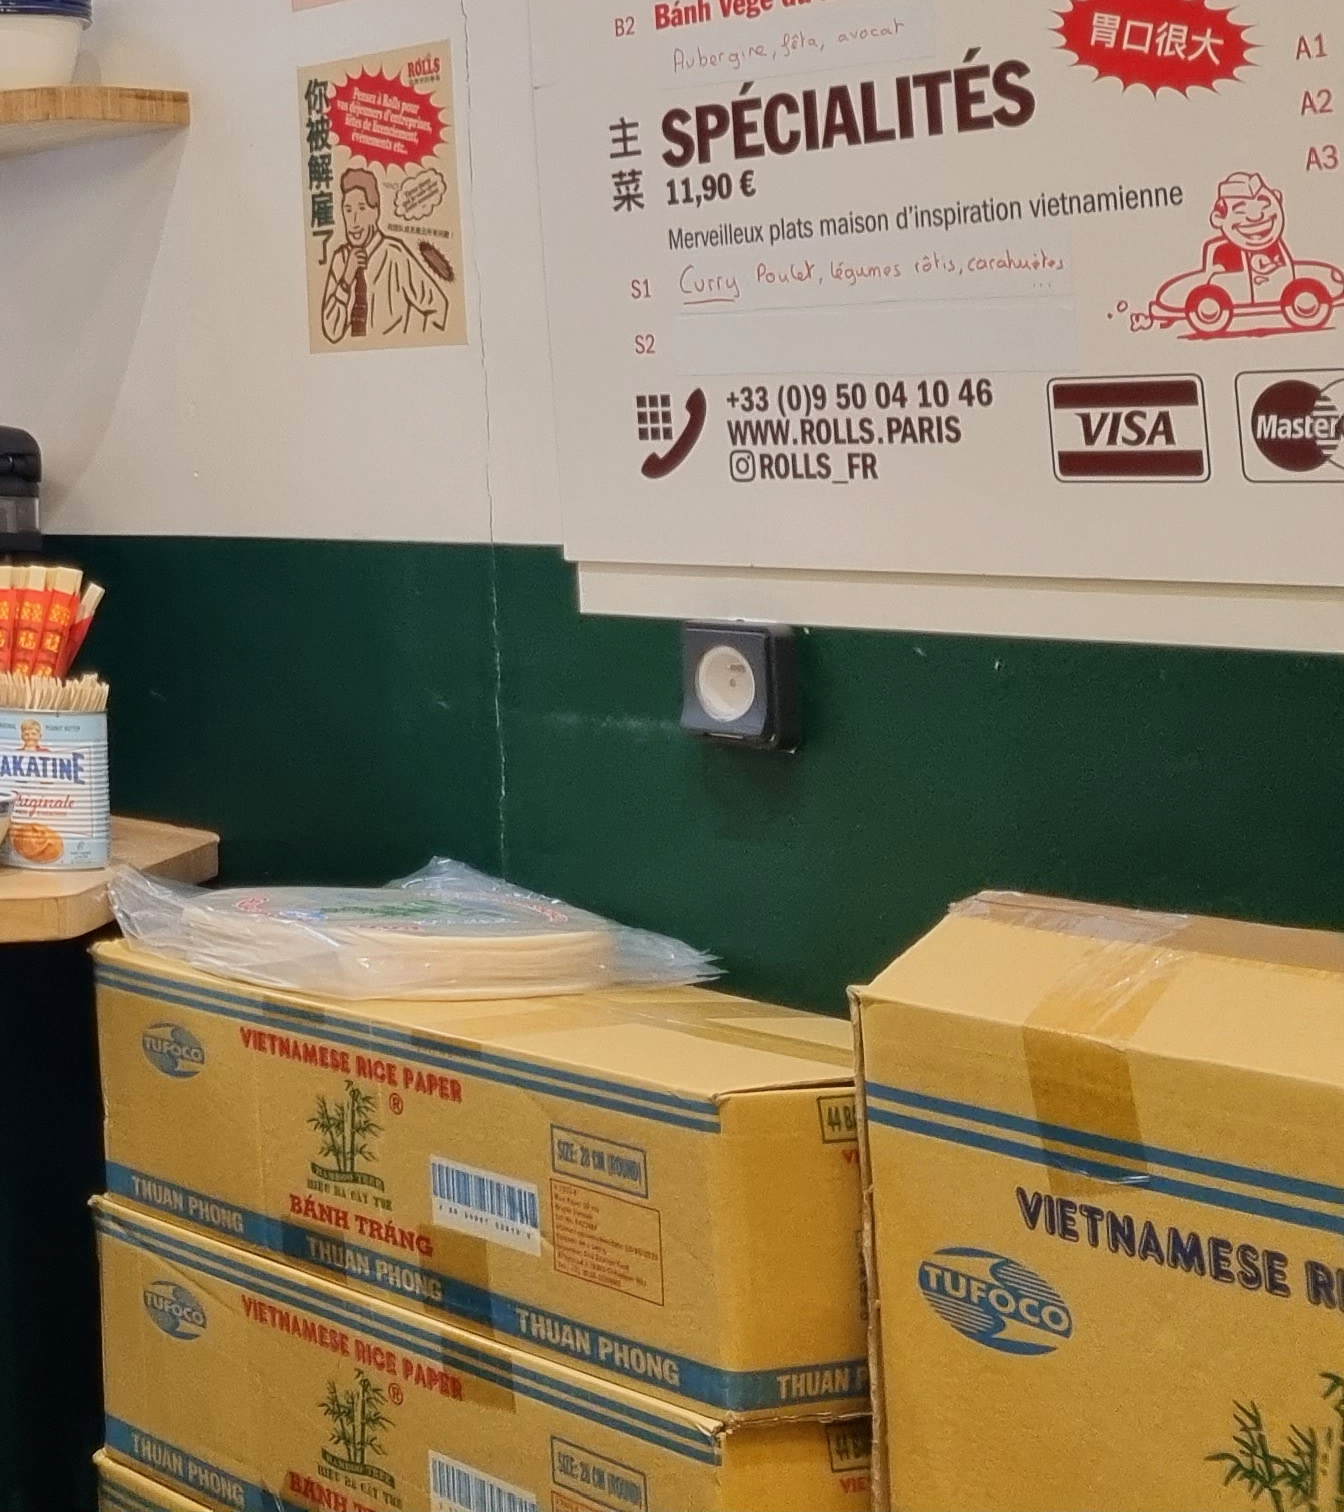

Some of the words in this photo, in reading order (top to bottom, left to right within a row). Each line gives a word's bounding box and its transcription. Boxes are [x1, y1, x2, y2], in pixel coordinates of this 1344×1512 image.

[1089, 12, 1225, 66] 胃口很大
[1296, 33, 1328, 60] A1
[661, 47, 1035, 168] SPÉCIALITÉS
[609, 116, 644, 213] 主菜
[668, 222, 765, 251] Merveilleux
[769, 217, 814, 247] plats
[819, 210, 889, 238] maison
[895, 197, 1023, 232] d'inspiration
[1028, 184, 1184, 219] vietnamienne
[632, 280, 652, 299] S1
[726, 385, 770, 414] +33
[777, 383, 828, 419] (0)9
[835, 381, 868, 411] 50
[874, 380, 909, 410] 04
[917, 379, 950, 409] 10
[957, 377, 994, 408] 46
[727, 416, 961, 446] WWW.ROLLS.PARIS
[1075, 410, 1176, 446] VISA
[1256, 413, 1344, 440] Master
[760, 452, 878, 483] ROLLS_FR
[143, 1038, 205, 1061] TUFOCO
[240, 1026, 351, 1075] VIETNAMESE
[355, 1054, 397, 1085] RICE
[403, 1067, 462, 1104] PAPER
[1015, 1185, 1290, 1297] VIETNAMESE
[921, 1263, 1071, 1335] TUFOCO
[516, 1308, 592, 1356] THUAN
[598, 1336, 680, 1387] PHONG
